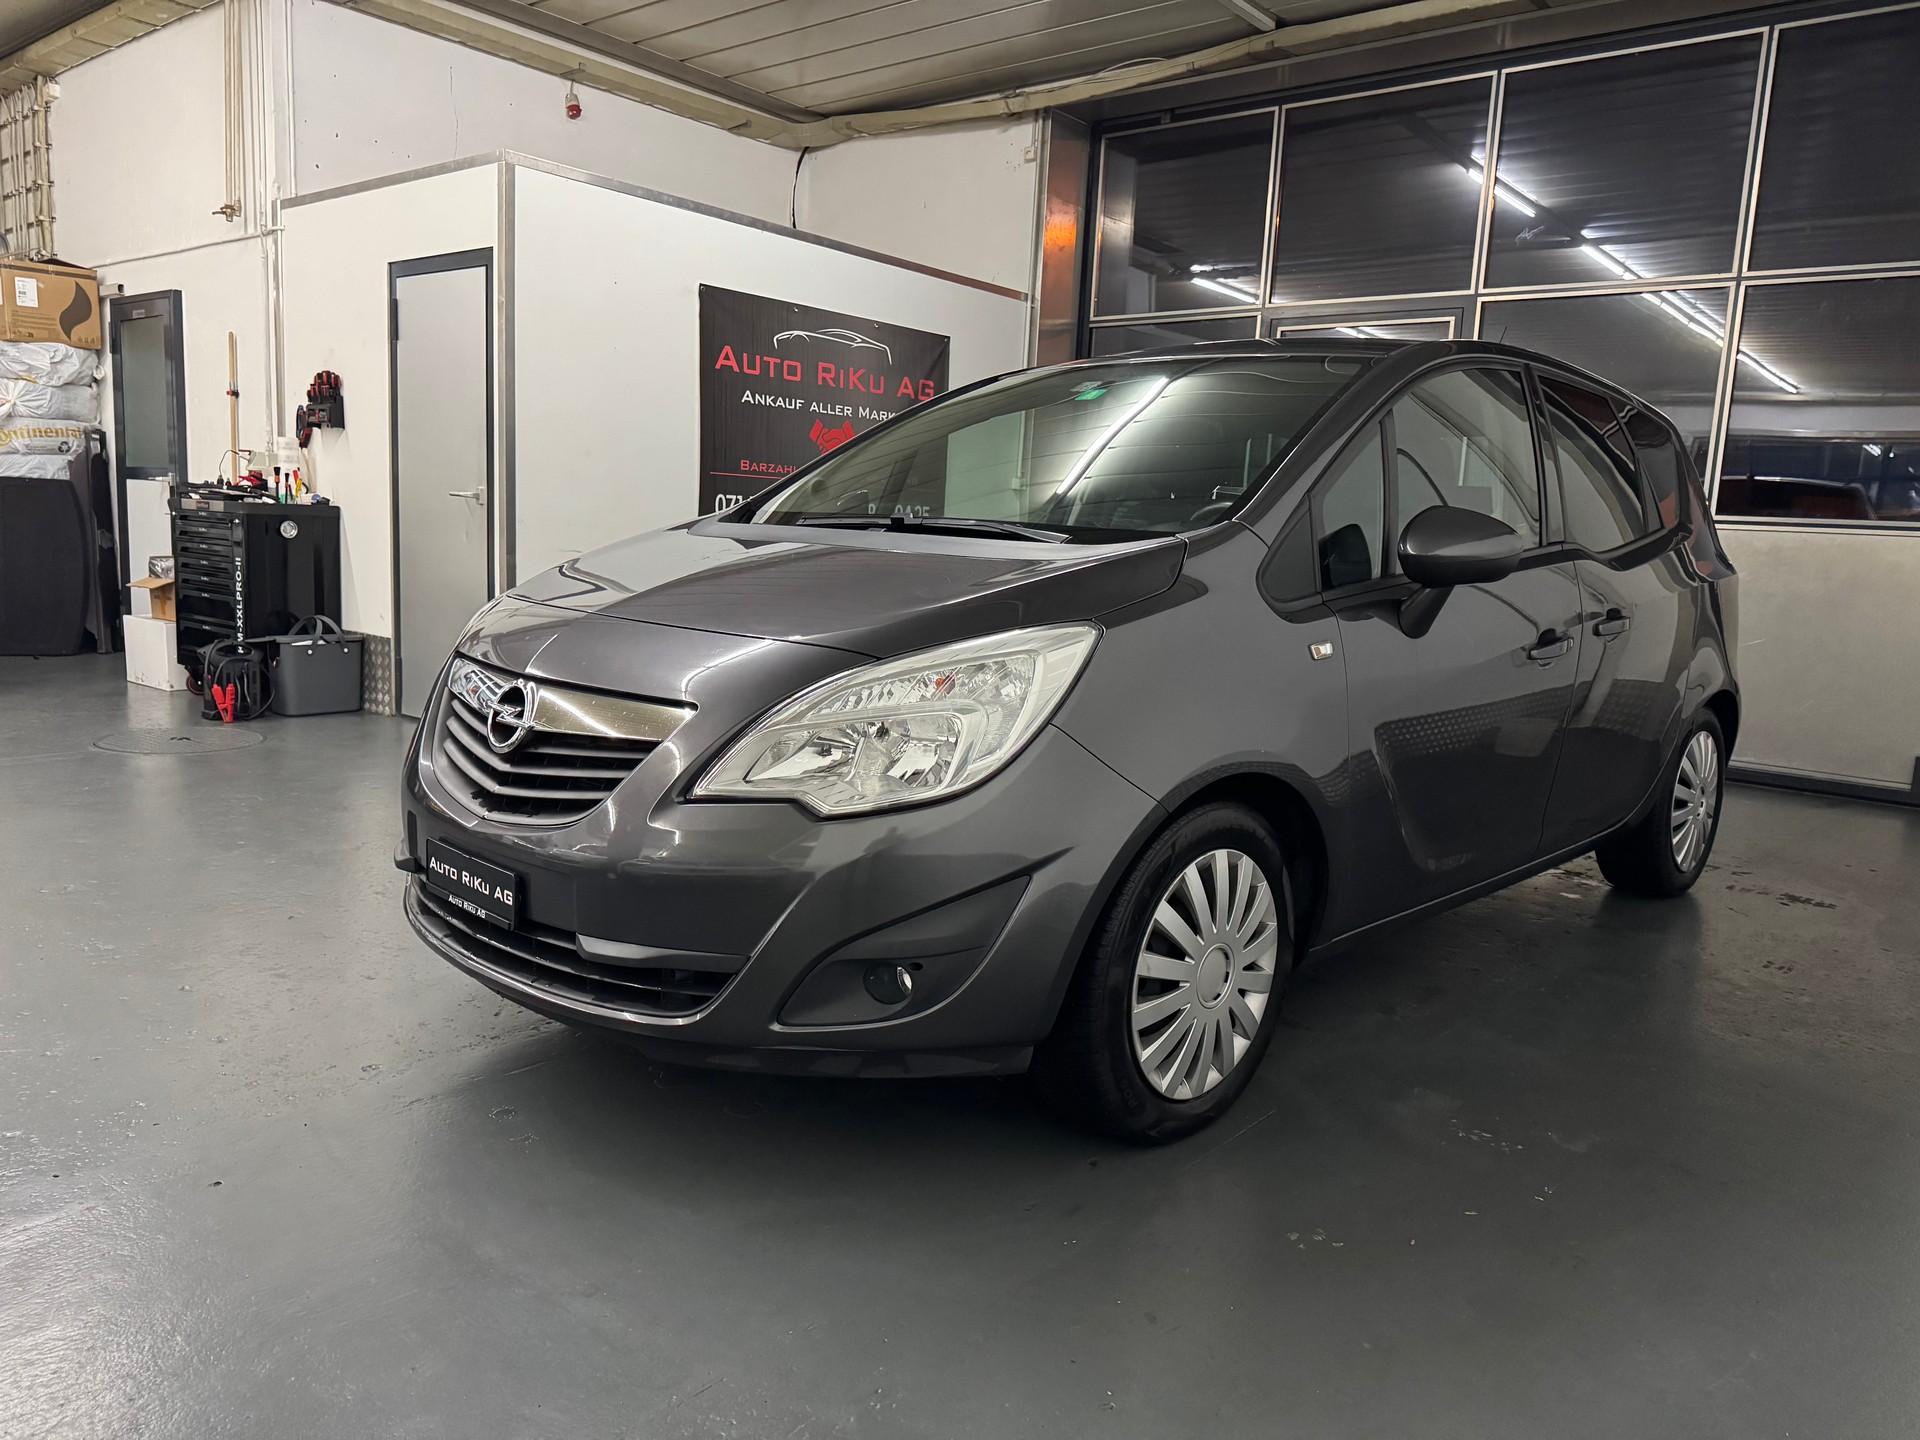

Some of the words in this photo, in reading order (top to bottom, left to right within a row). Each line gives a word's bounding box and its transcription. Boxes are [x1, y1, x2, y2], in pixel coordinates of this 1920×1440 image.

[897, 376, 935, 400] AG
[741, 390, 805, 410] ANKAUF
[809, 401, 853, 417] ALLER
[429, 856, 458, 880] AUTO
[493, 886, 513, 906] AG
